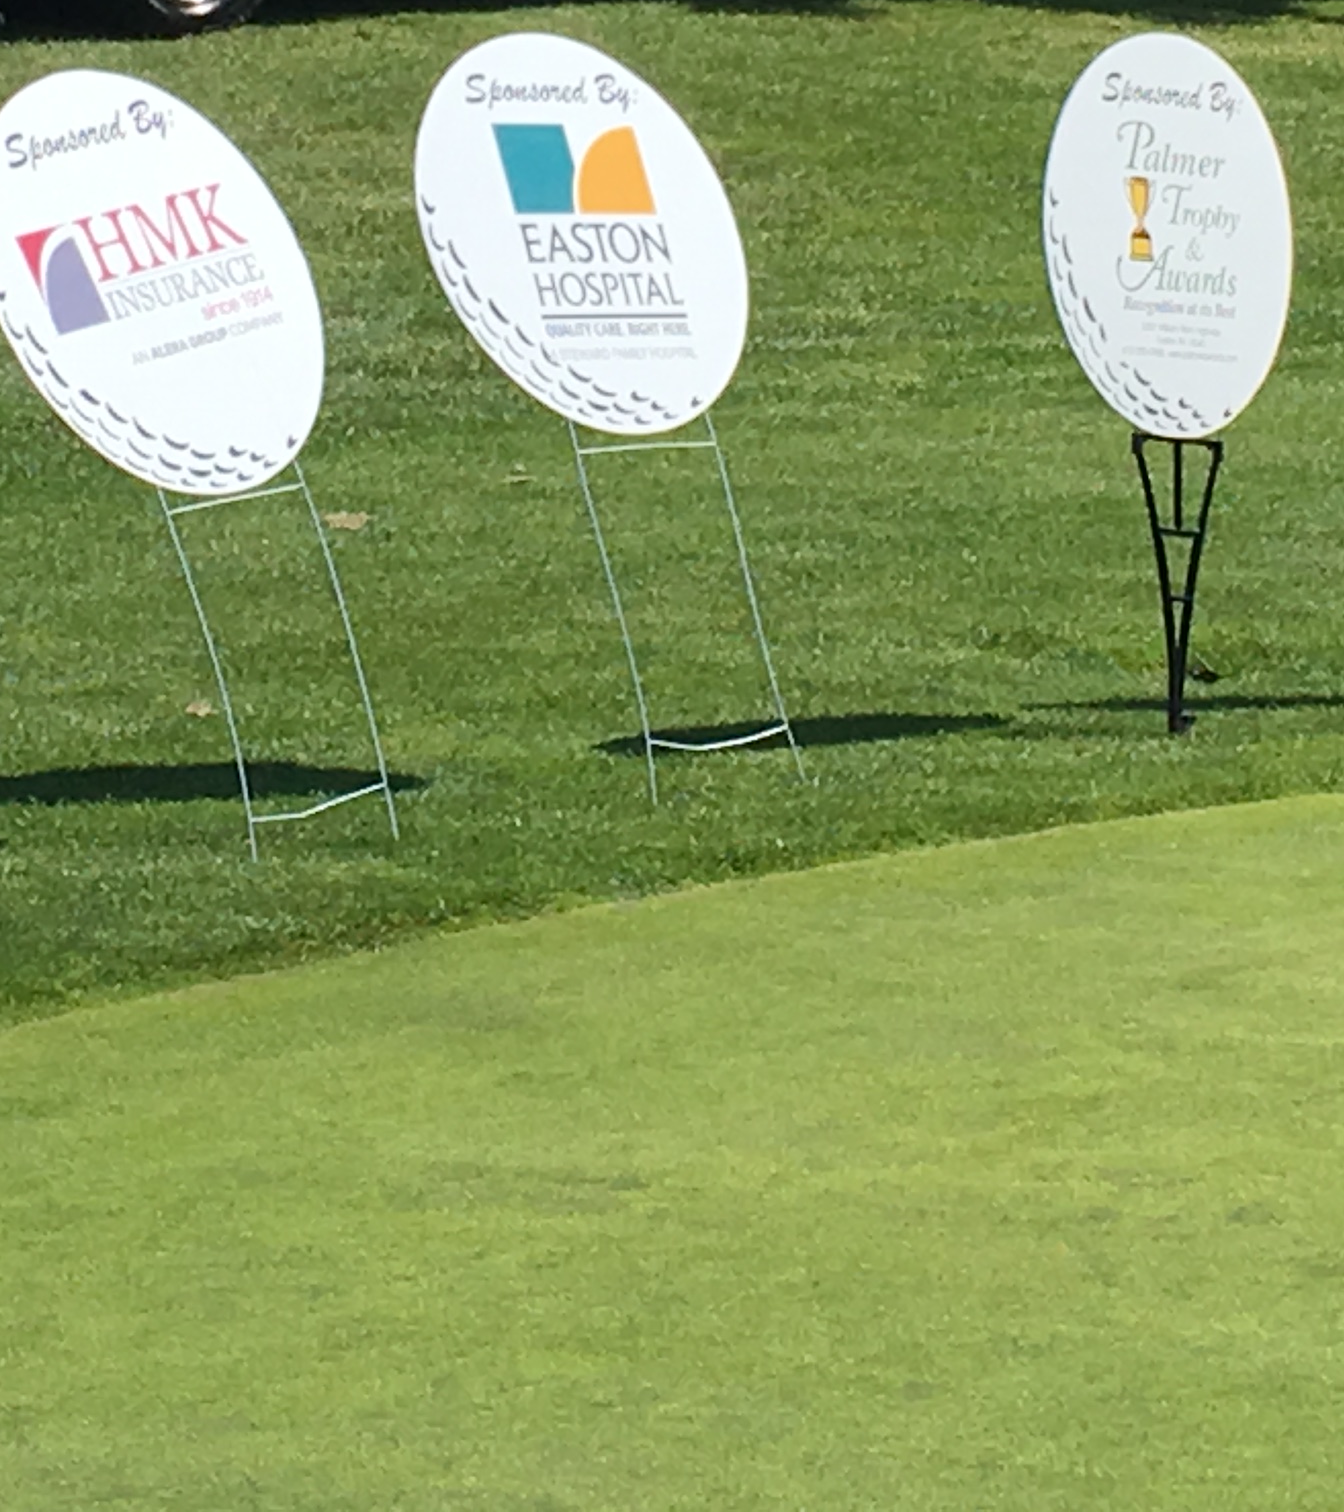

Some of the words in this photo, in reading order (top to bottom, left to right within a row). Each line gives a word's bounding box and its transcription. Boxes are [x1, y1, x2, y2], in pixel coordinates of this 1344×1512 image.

[465, 74, 589, 109] Sponsored
[593, 74, 638, 112] By:
[1101, 72, 1203, 110] Sponsored
[1208, 81, 1243, 123] By:
[5, 110, 126, 170] Sponsored
[127, 99, 175, 139] By:
[1116, 119, 1226, 179] Palmer
[73, 183, 249, 283] HMK
[1162, 184, 1241, 238] Trophy
[520, 222, 674, 264] EASTON
[1185, 237, 1206, 263] &
[105, 252, 266, 321] INSURANCE
[534, 272, 685, 308] HOSPITAL
[1116, 245, 1238, 297] Awards
[545, 322, 592, 339] QUALITY
